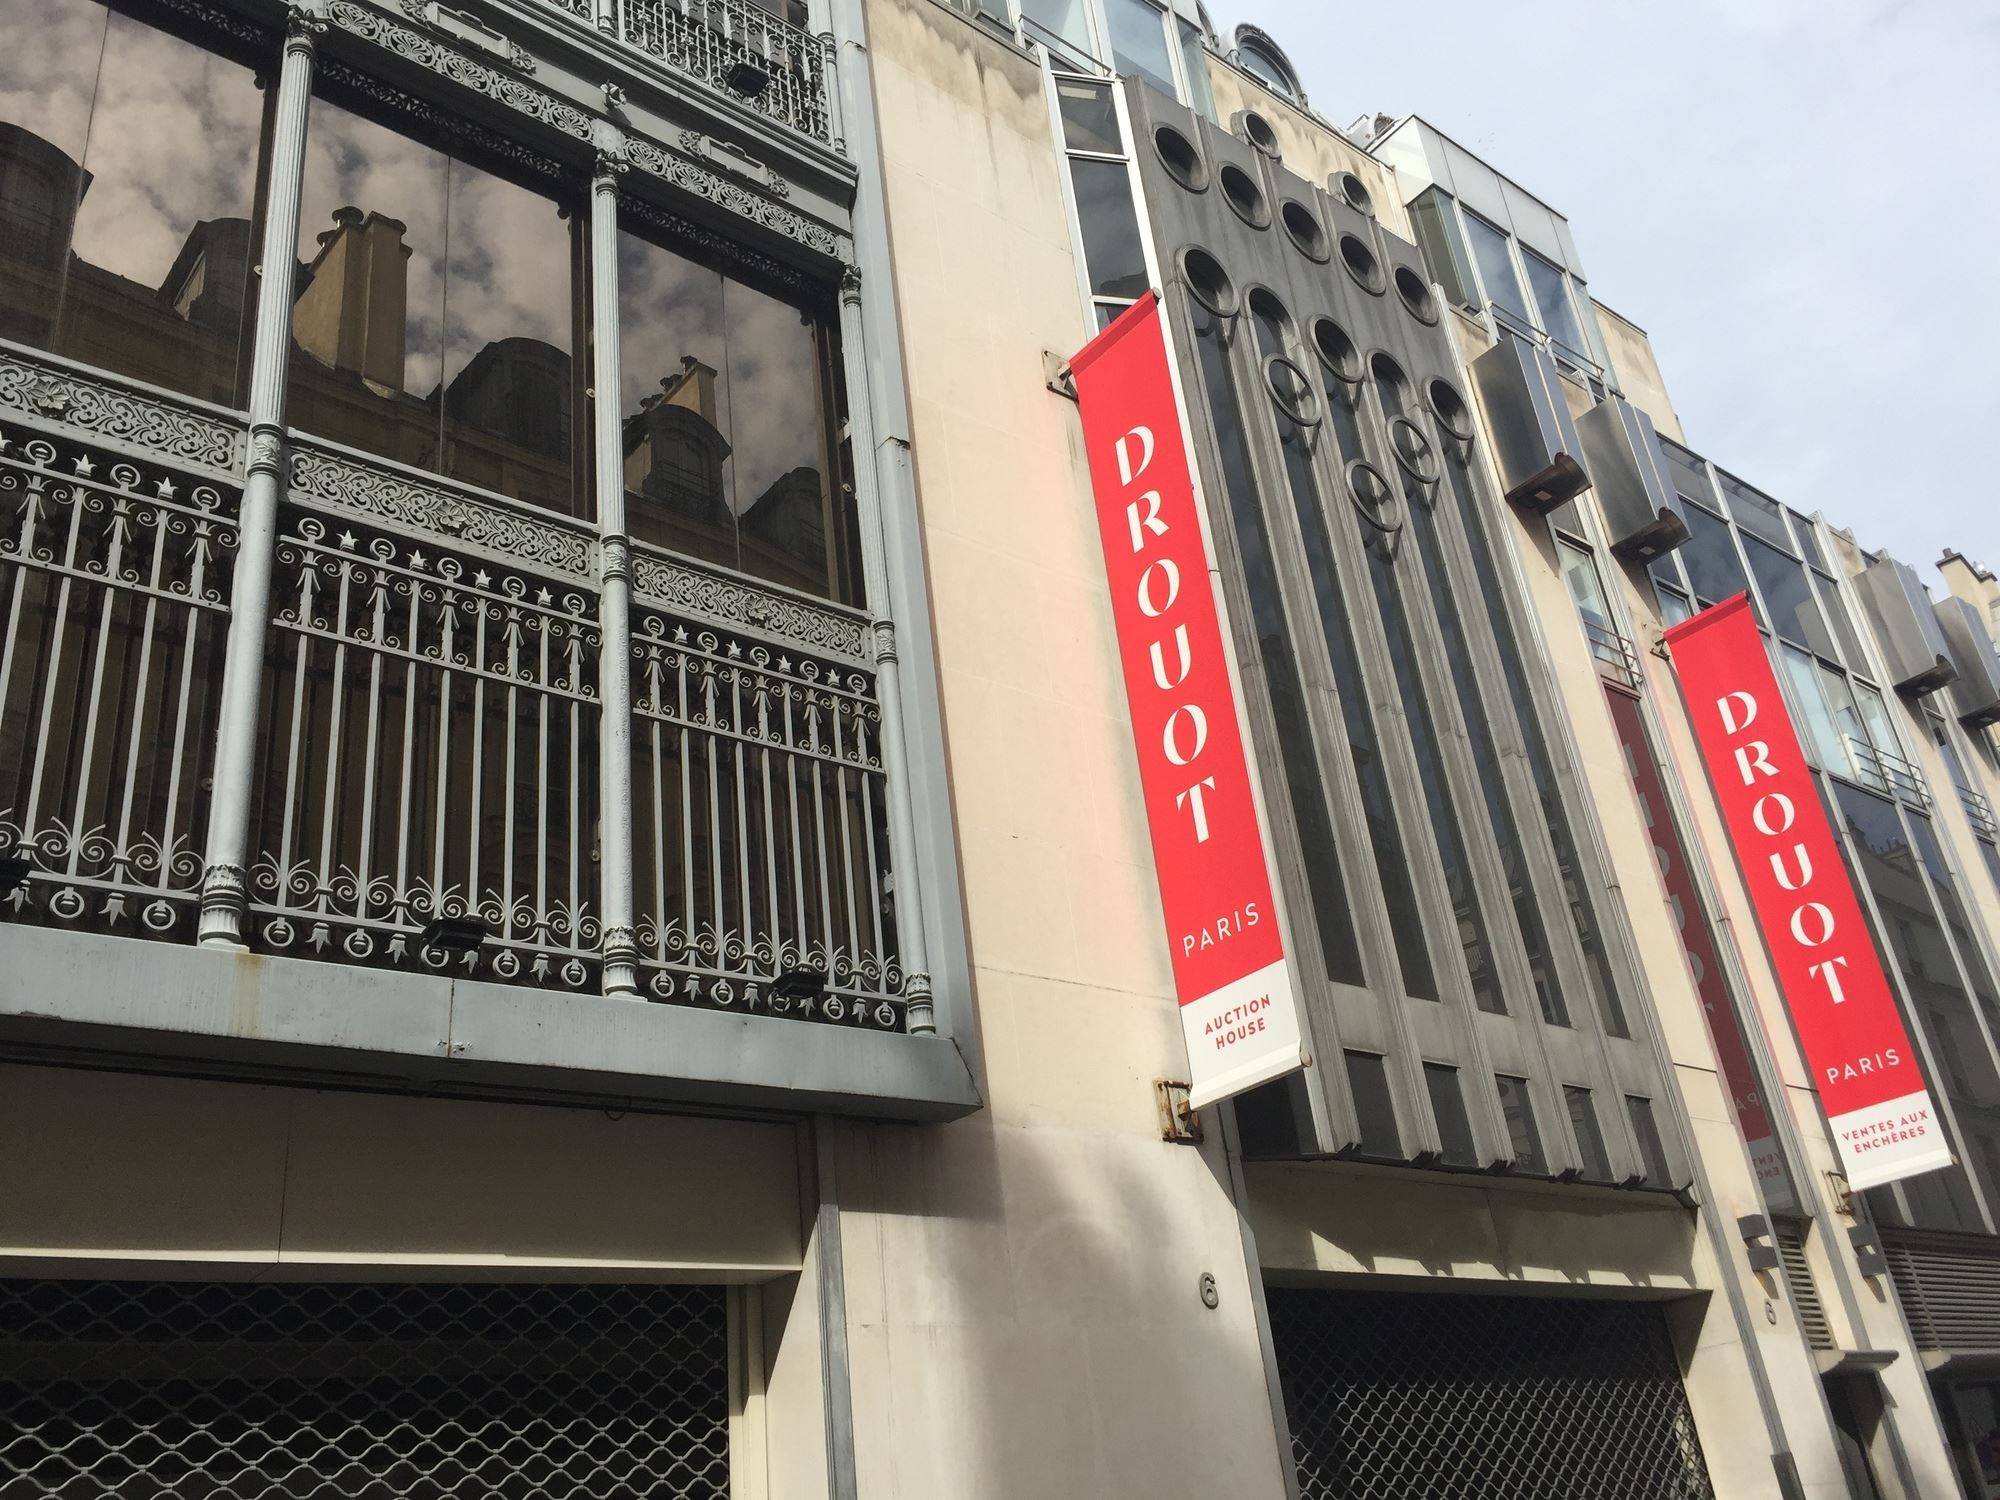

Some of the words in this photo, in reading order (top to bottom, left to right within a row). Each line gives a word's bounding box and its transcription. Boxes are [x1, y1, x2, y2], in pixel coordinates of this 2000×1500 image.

[1115, 425, 1216, 844] DROUOT
[1716, 690, 1848, 1004] DROUOT
[1183, 902, 1259, 958] PARIS
[1204, 994, 1271, 1035] AUCTION
[1215, 1017, 1266, 1050] HOUSE
[1826, 1048, 1901, 1085] PARIS
[1842, 1119, 1895, 1141] VENTES
[1900, 1110, 1929, 1126] AUX
[1854, 1125, 1927, 1154] ENCHÈRES
[1199, 1272, 1219, 1310] 6
